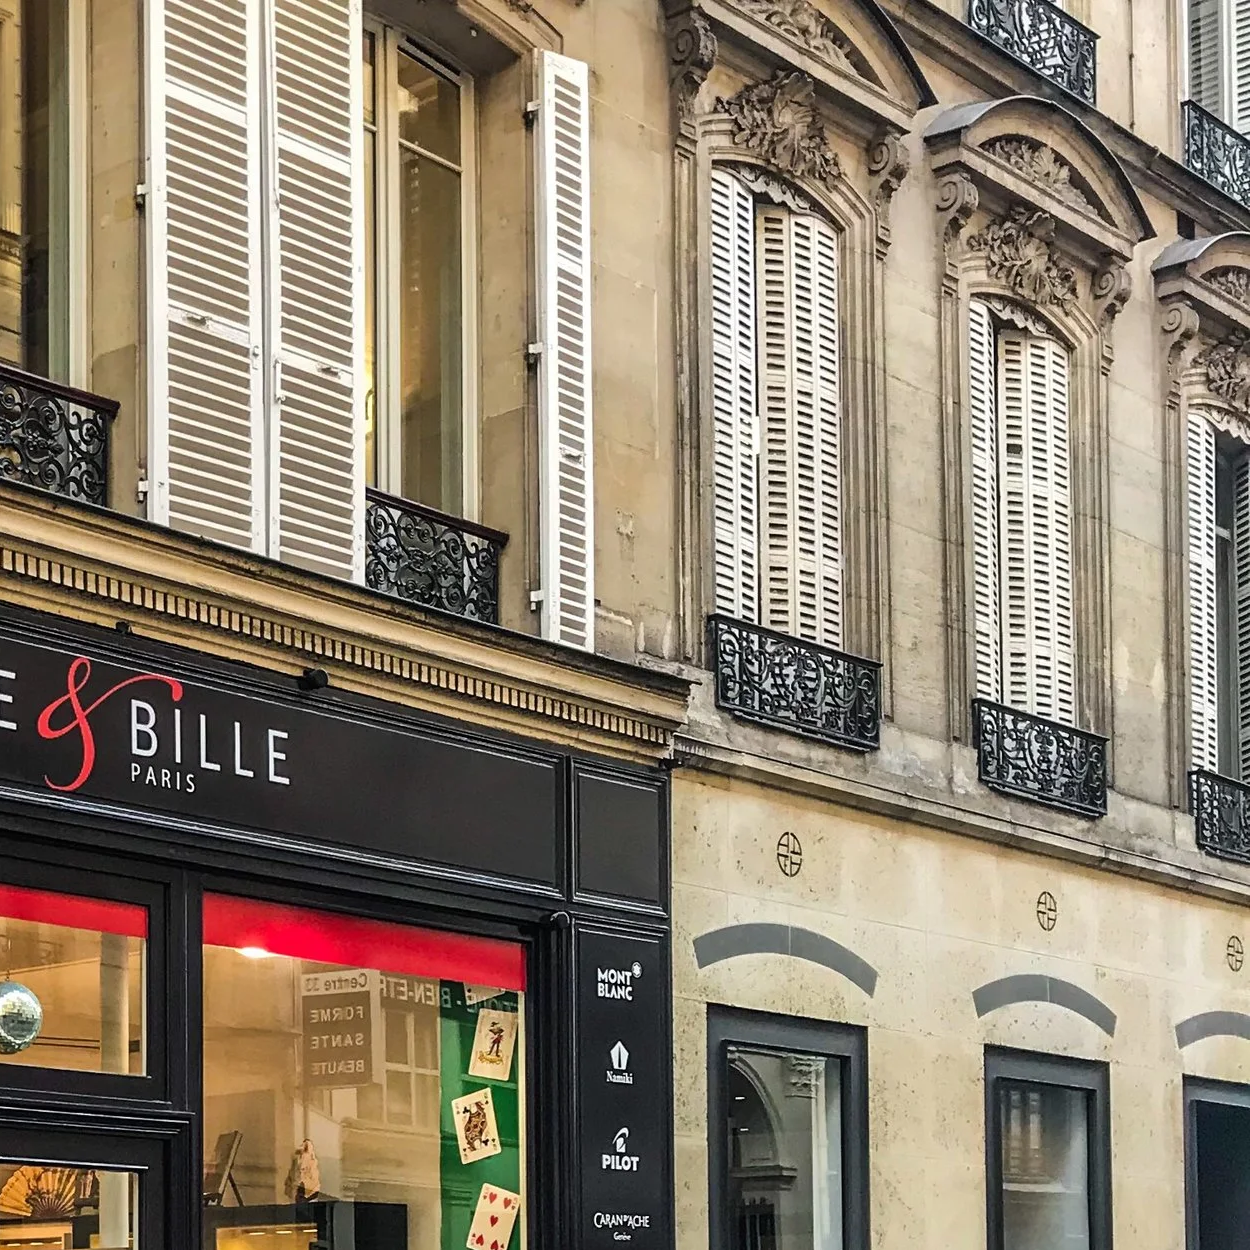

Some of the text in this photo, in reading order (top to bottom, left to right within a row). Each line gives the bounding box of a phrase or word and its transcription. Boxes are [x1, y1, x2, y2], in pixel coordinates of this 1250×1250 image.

[37, 656, 183, 792] &
[130, 698, 291, 786] BILLE
[130, 763, 196, 793] PARIS
[597, 968, 632, 985] MONT
[597, 984, 633, 1001] BLANC
[606, 1070, 633, 1085] Namiki
[602, 1155, 639, 1171] PILOT
